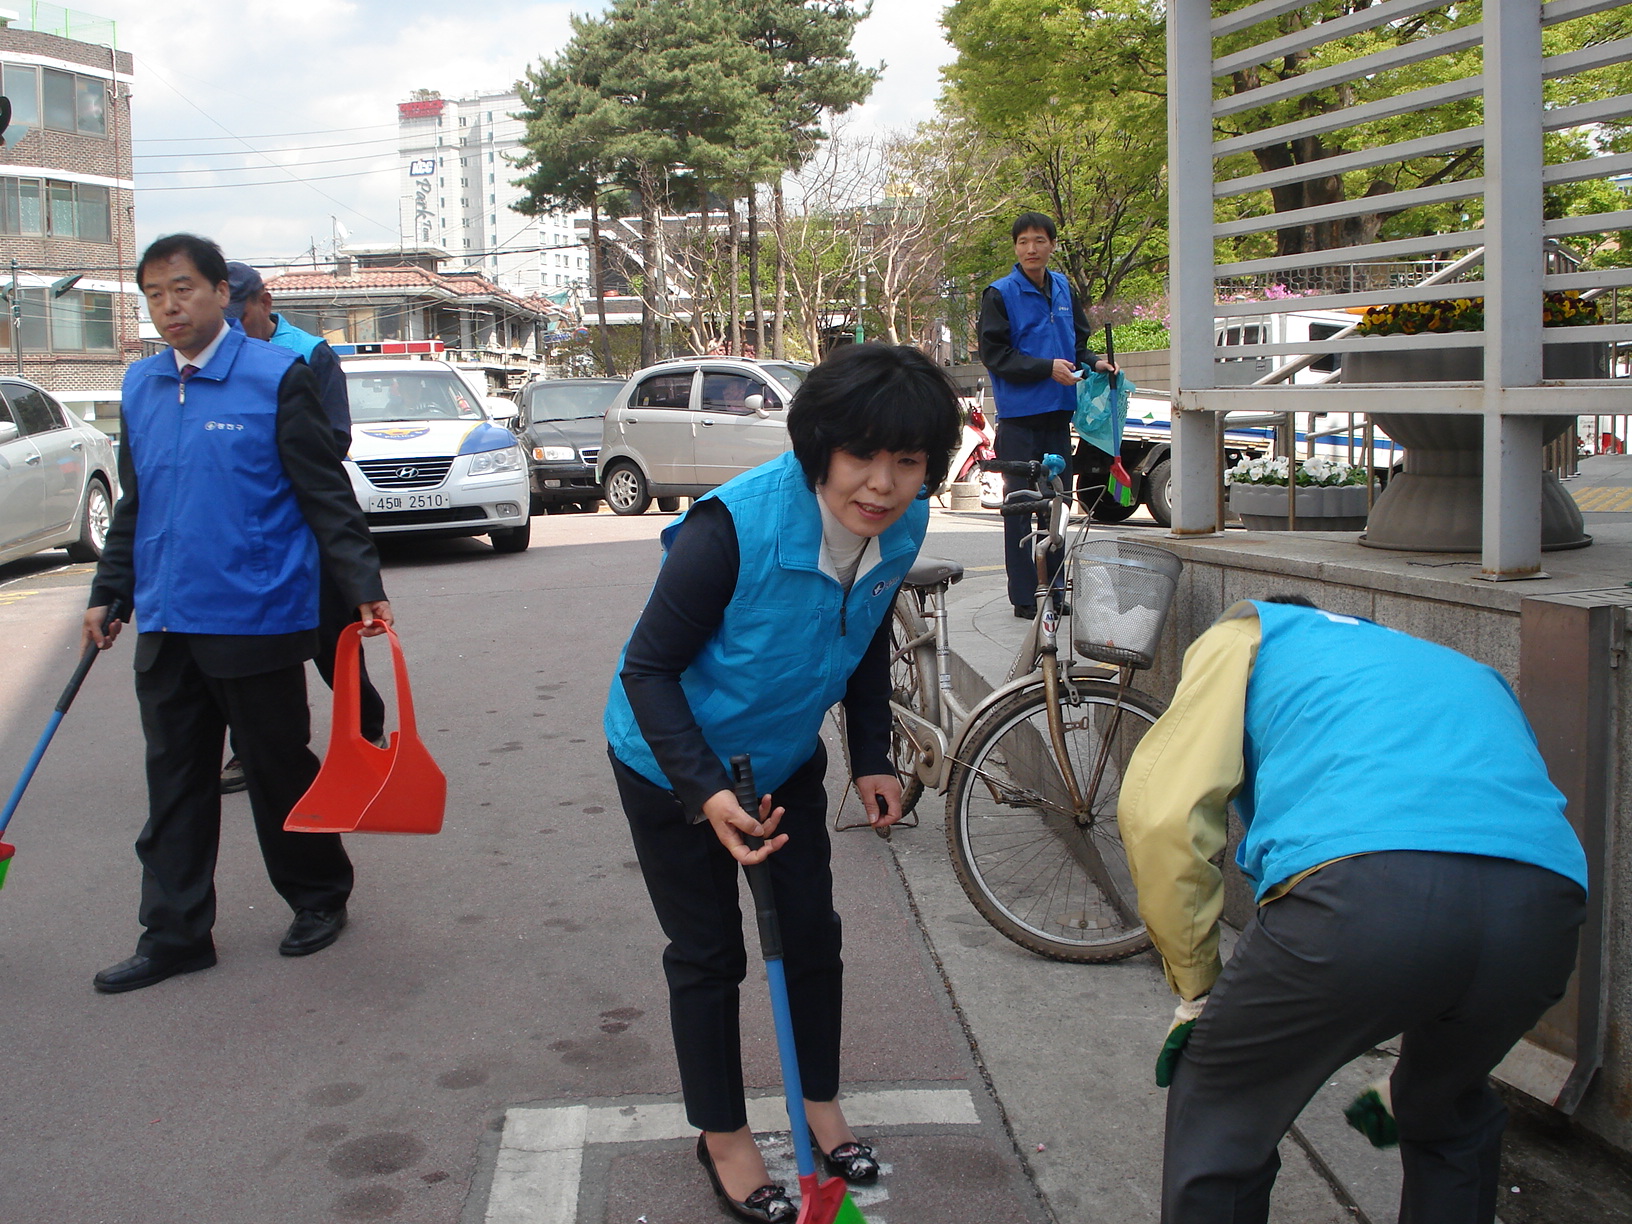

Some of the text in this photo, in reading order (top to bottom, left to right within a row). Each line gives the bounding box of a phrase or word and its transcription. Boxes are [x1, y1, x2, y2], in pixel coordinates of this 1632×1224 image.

[415, 178, 435, 220] Park
[377, 494, 443, 510] 45마 2510
